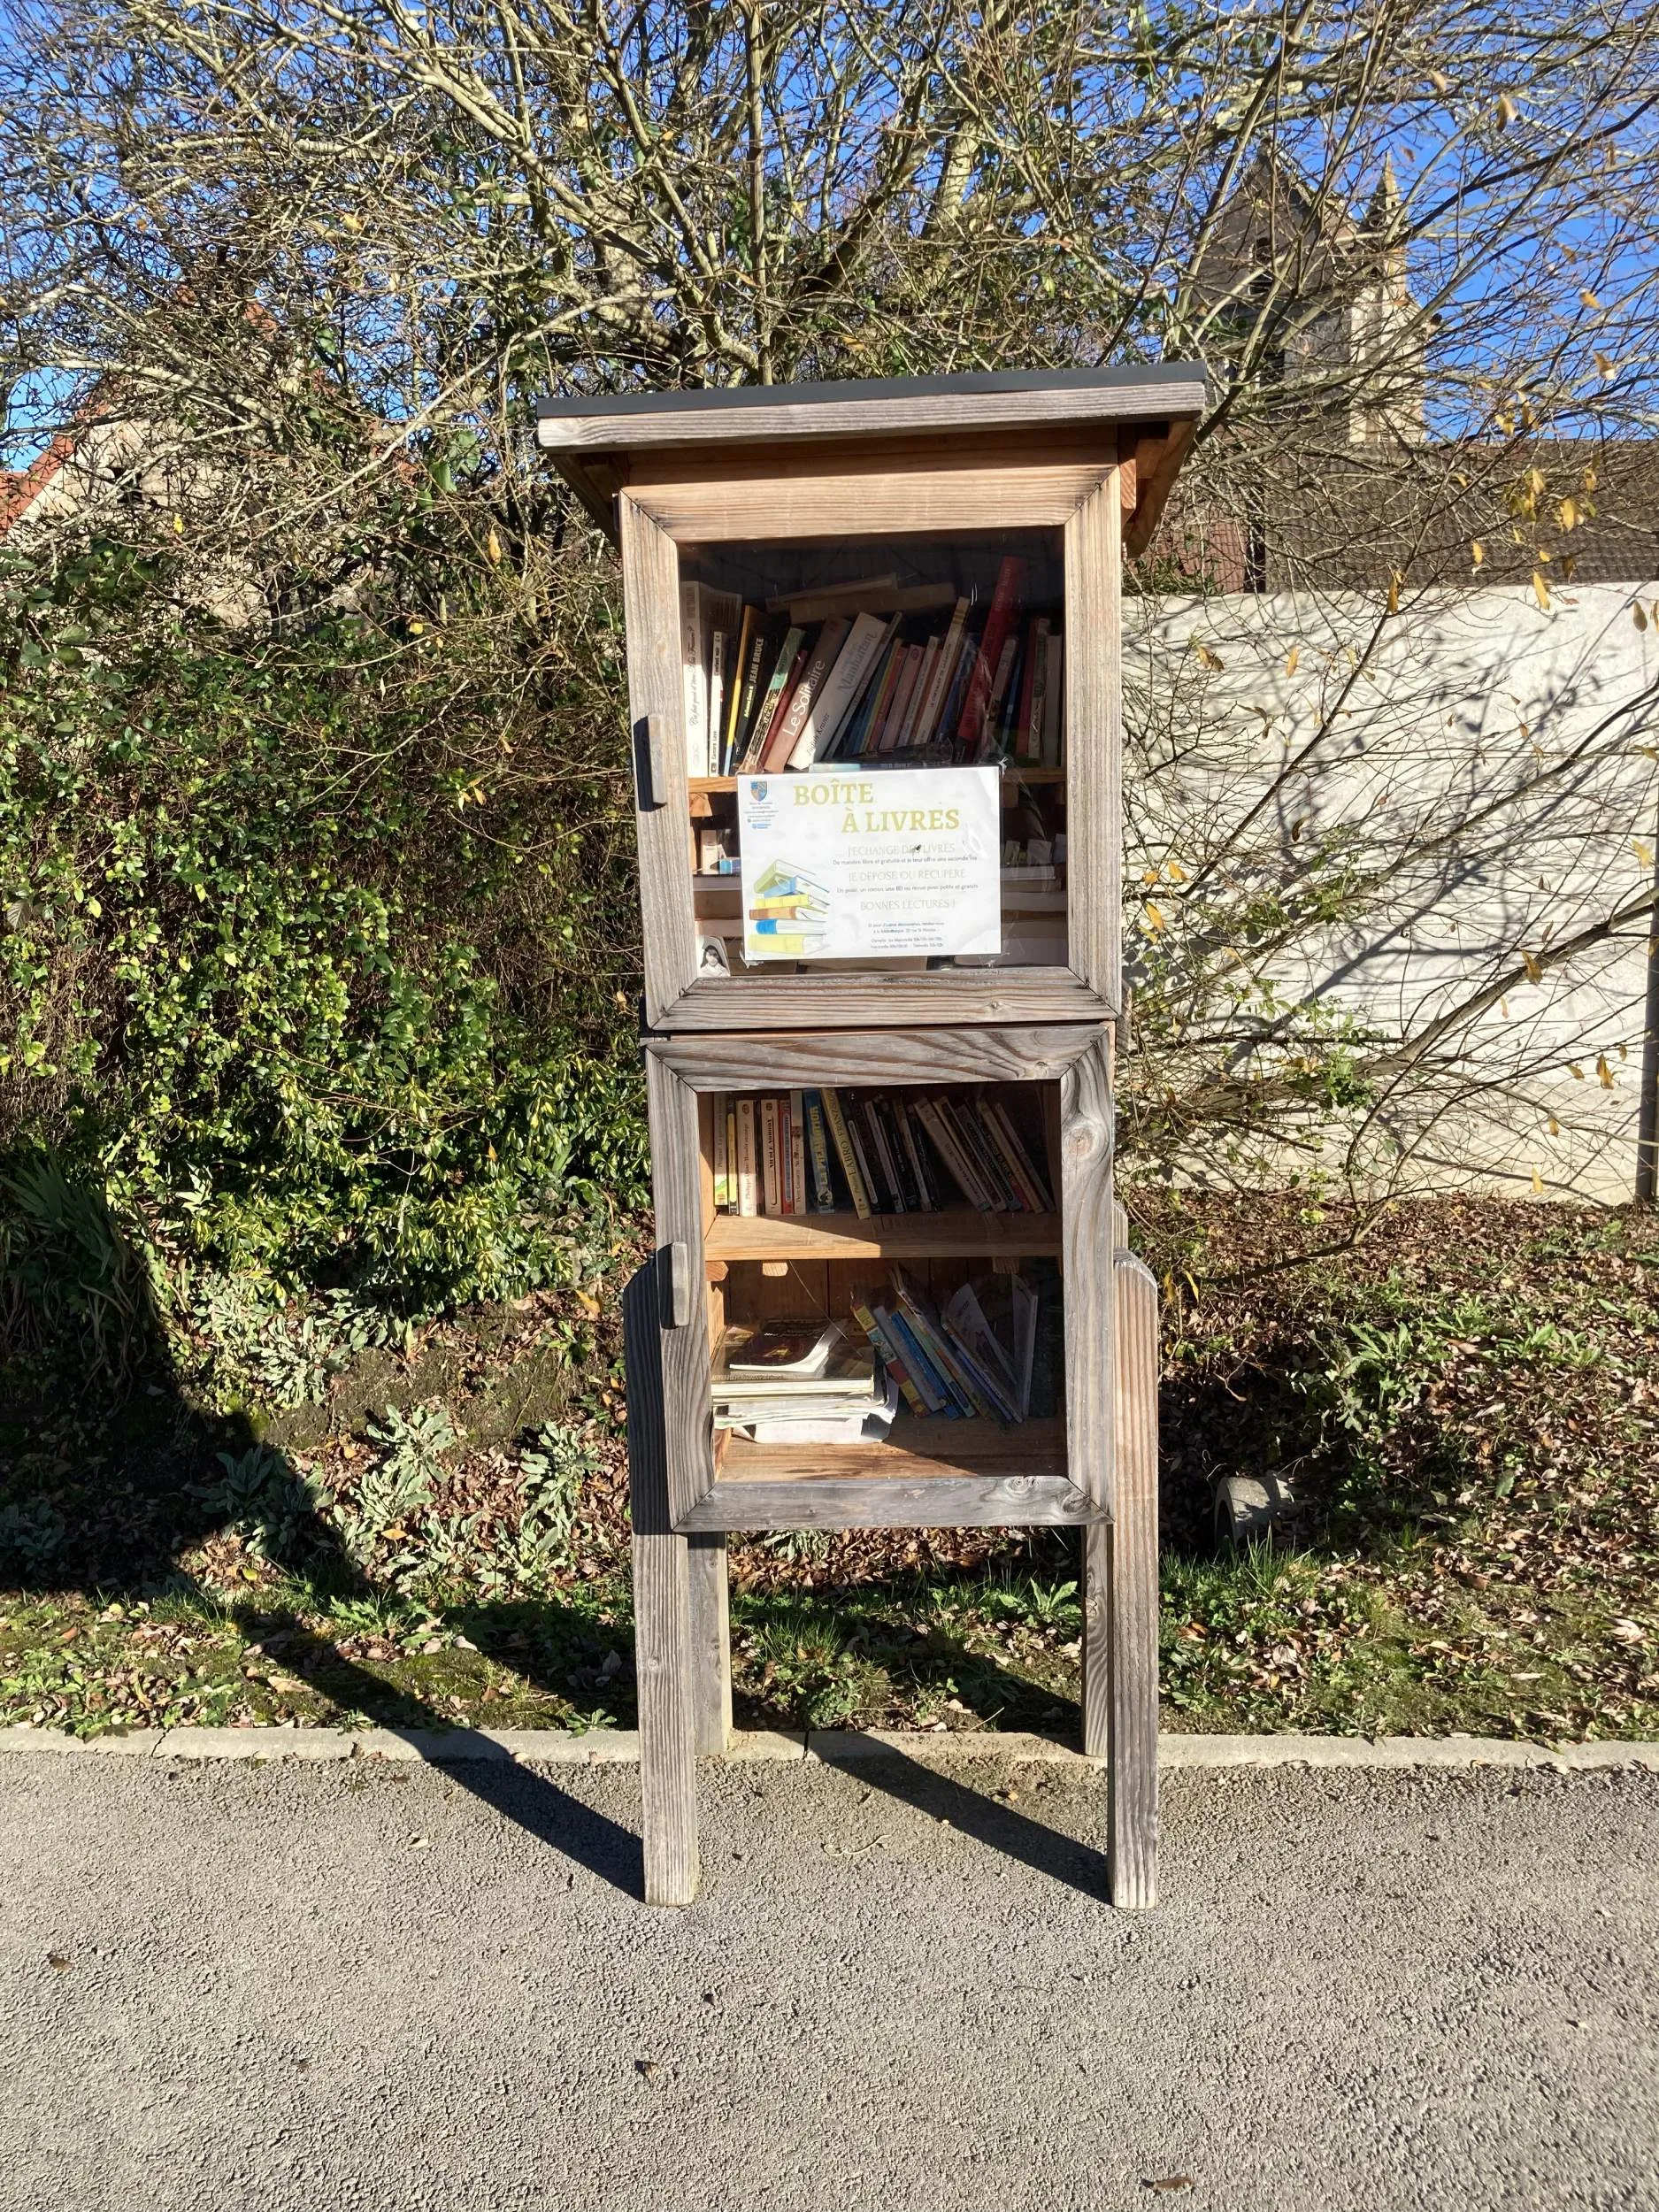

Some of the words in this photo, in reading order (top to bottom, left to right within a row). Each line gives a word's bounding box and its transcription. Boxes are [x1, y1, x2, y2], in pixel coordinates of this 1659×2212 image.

[753, 637, 764, 662] BRUCE
[838, 632, 876, 692] Manhattan
[749, 664, 759, 683] JEAN
[782, 718, 801, 737] Le
[792, 659, 826, 716] Solitaire
[793, 779, 874, 806] BOÎTE
[841, 807, 859, 833] À
[865, 809, 960, 833] LIVRES
[923, 841, 956, 854] LIVRES
[860, 900, 899, 911] BONNES
[902, 898, 949, 910] LECTURES
[841, 1141, 856, 1175] LABRO
